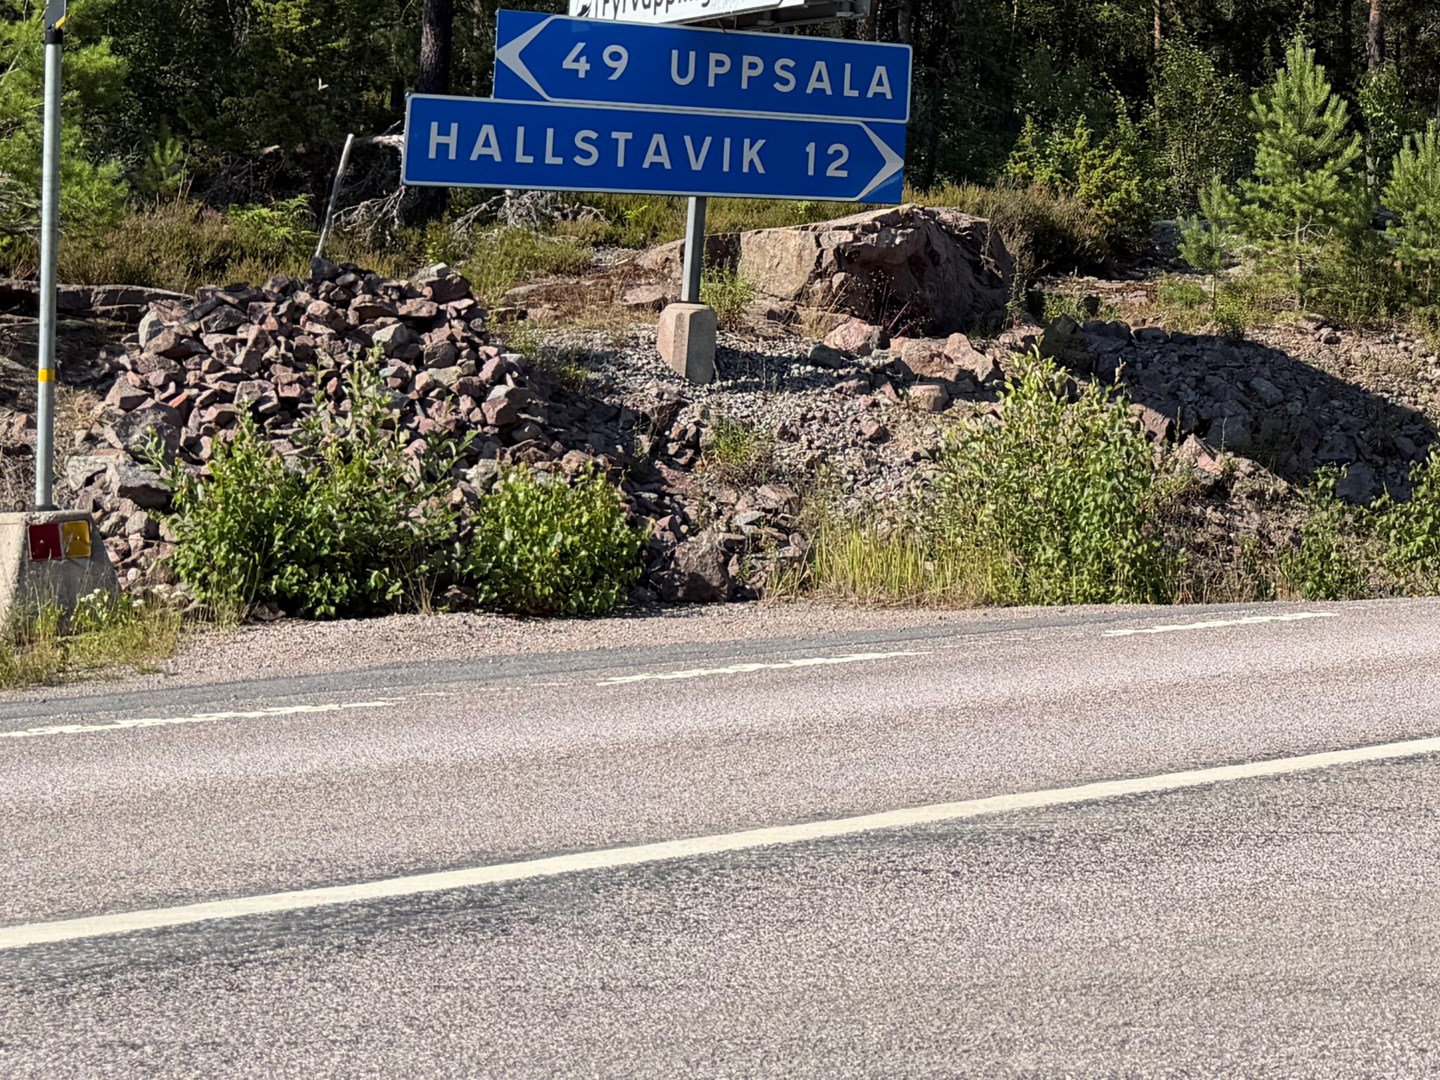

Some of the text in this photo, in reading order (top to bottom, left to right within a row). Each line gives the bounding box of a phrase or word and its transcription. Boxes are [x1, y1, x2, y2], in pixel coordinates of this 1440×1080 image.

[561, 41, 893, 100] 49 UPPSALA
[428, 121, 850, 177] HALLSTAVIK 12
